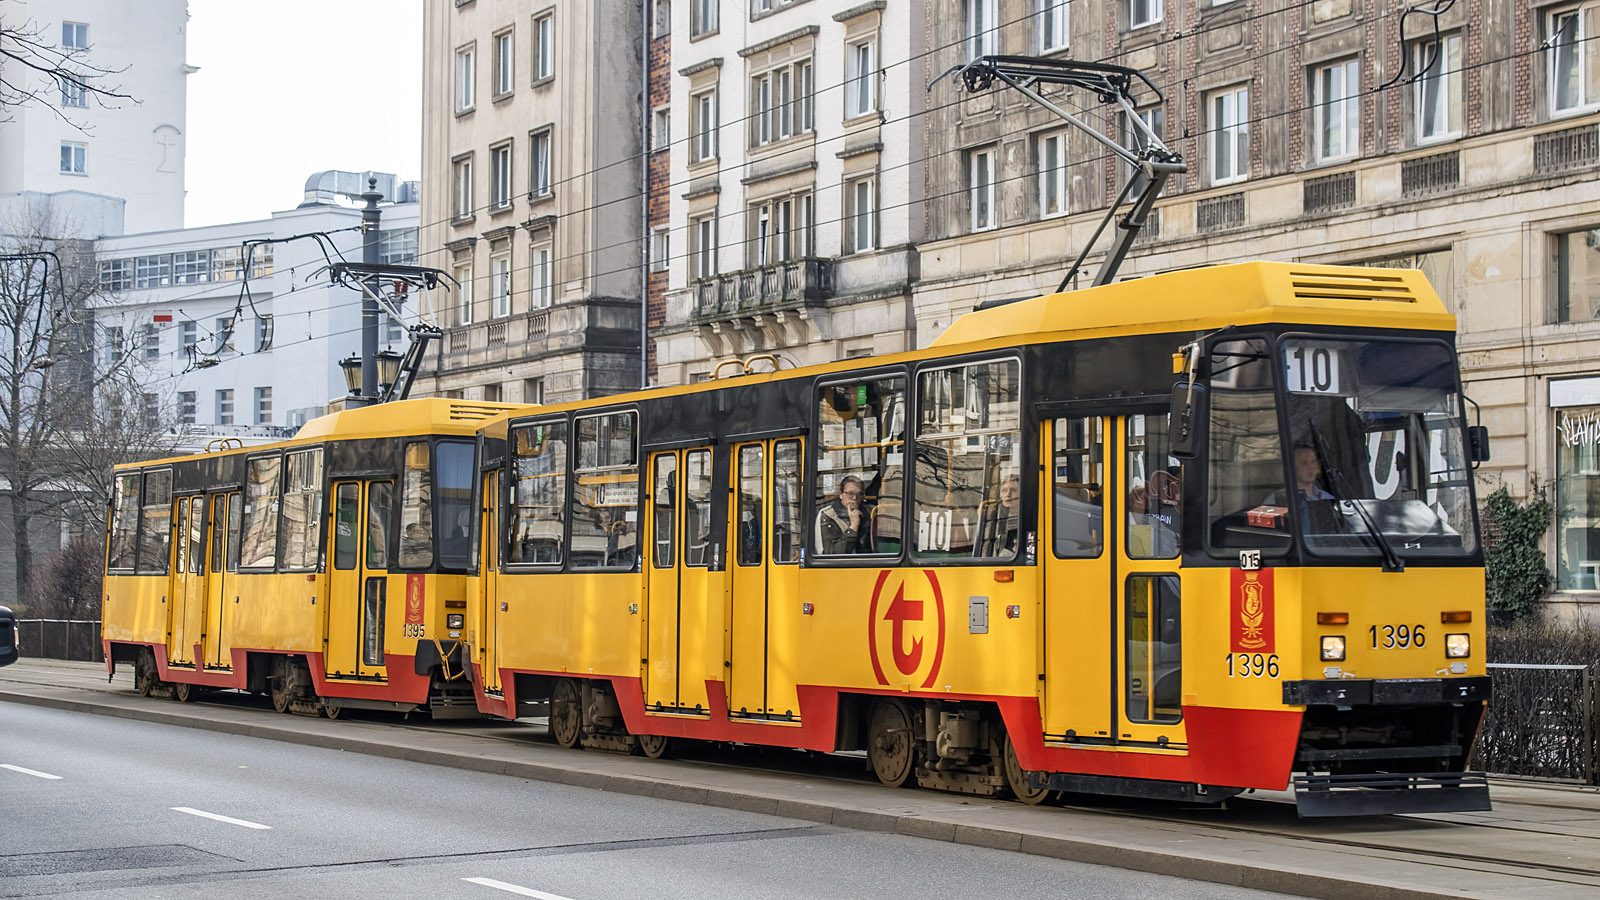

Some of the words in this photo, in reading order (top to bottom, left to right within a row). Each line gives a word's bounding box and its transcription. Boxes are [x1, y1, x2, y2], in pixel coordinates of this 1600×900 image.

[926, 511, 947, 550] 10
[1241, 553, 1260, 568] 015
[404, 623, 426, 638] 1395
[1369, 624, 1427, 650] 1396
[1226, 653, 1280, 678] 1396
